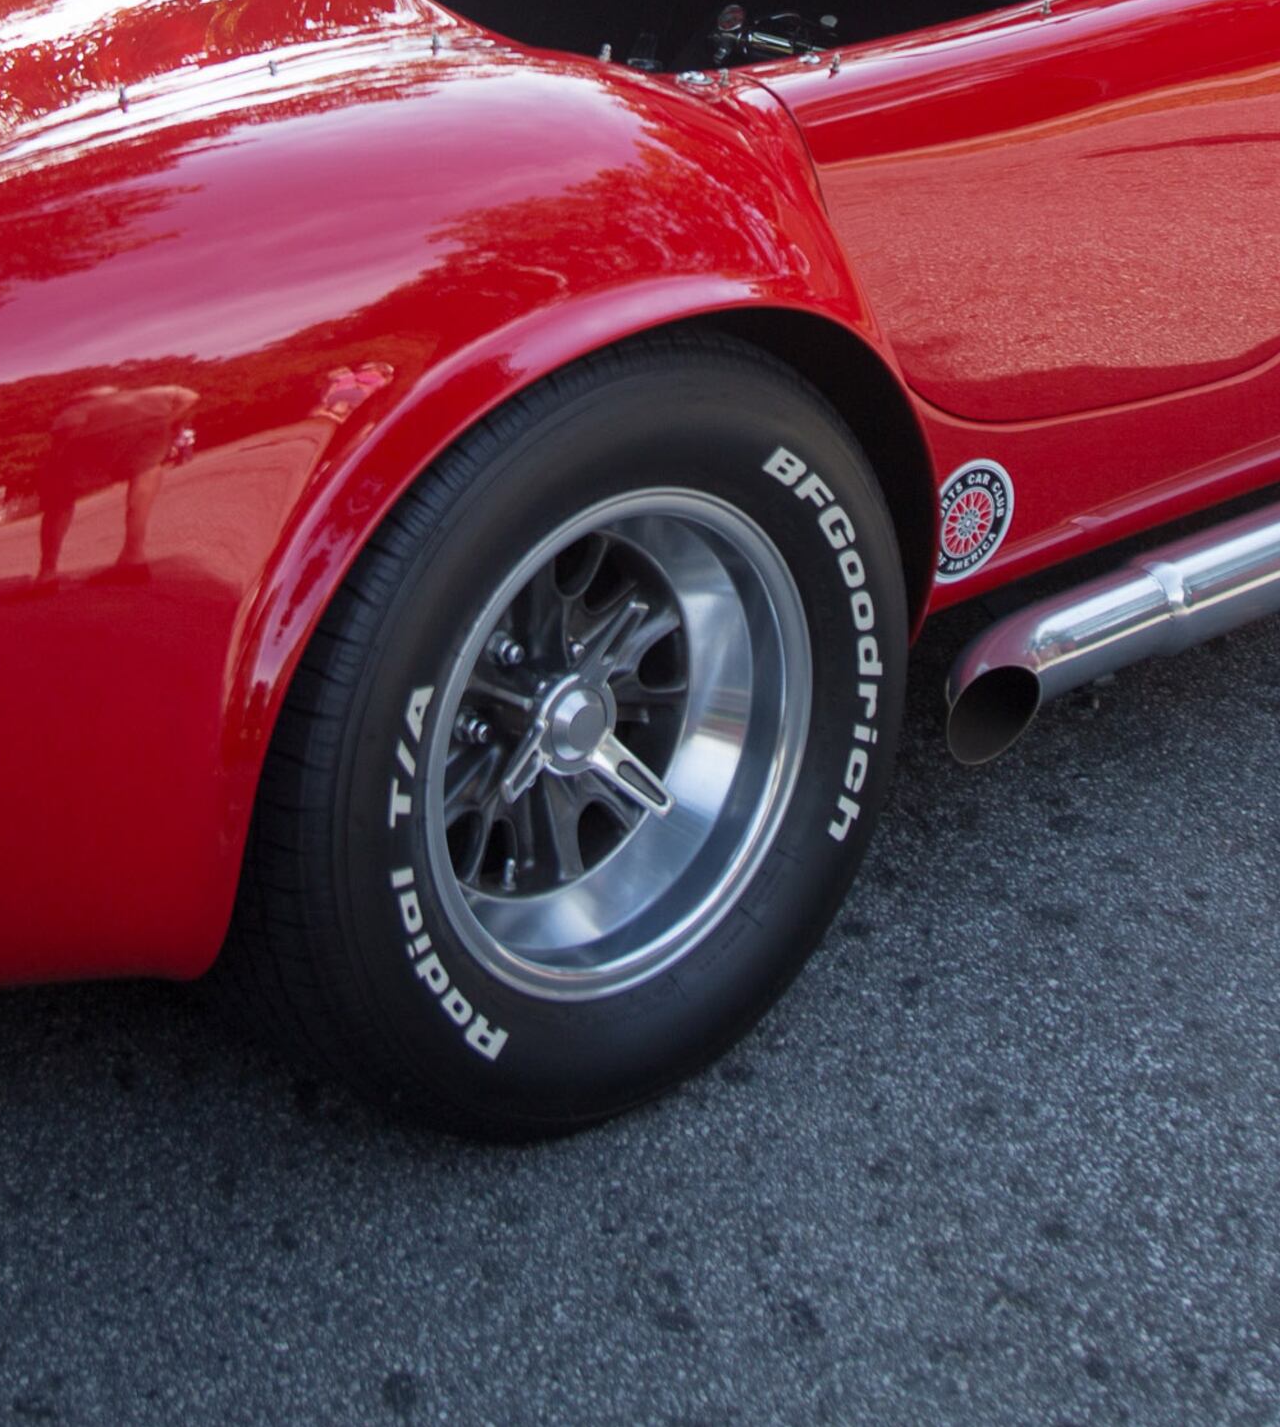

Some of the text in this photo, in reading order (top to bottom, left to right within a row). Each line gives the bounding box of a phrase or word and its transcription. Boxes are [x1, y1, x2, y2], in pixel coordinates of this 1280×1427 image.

[947, 533, 997, 572] AMERICA
[967, 473, 991, 486] CAR
[991, 482, 1006, 518] CLUB
[762, 445, 883, 843] BFGoodrich
[388, 685, 509, 1062] Radial T/A
